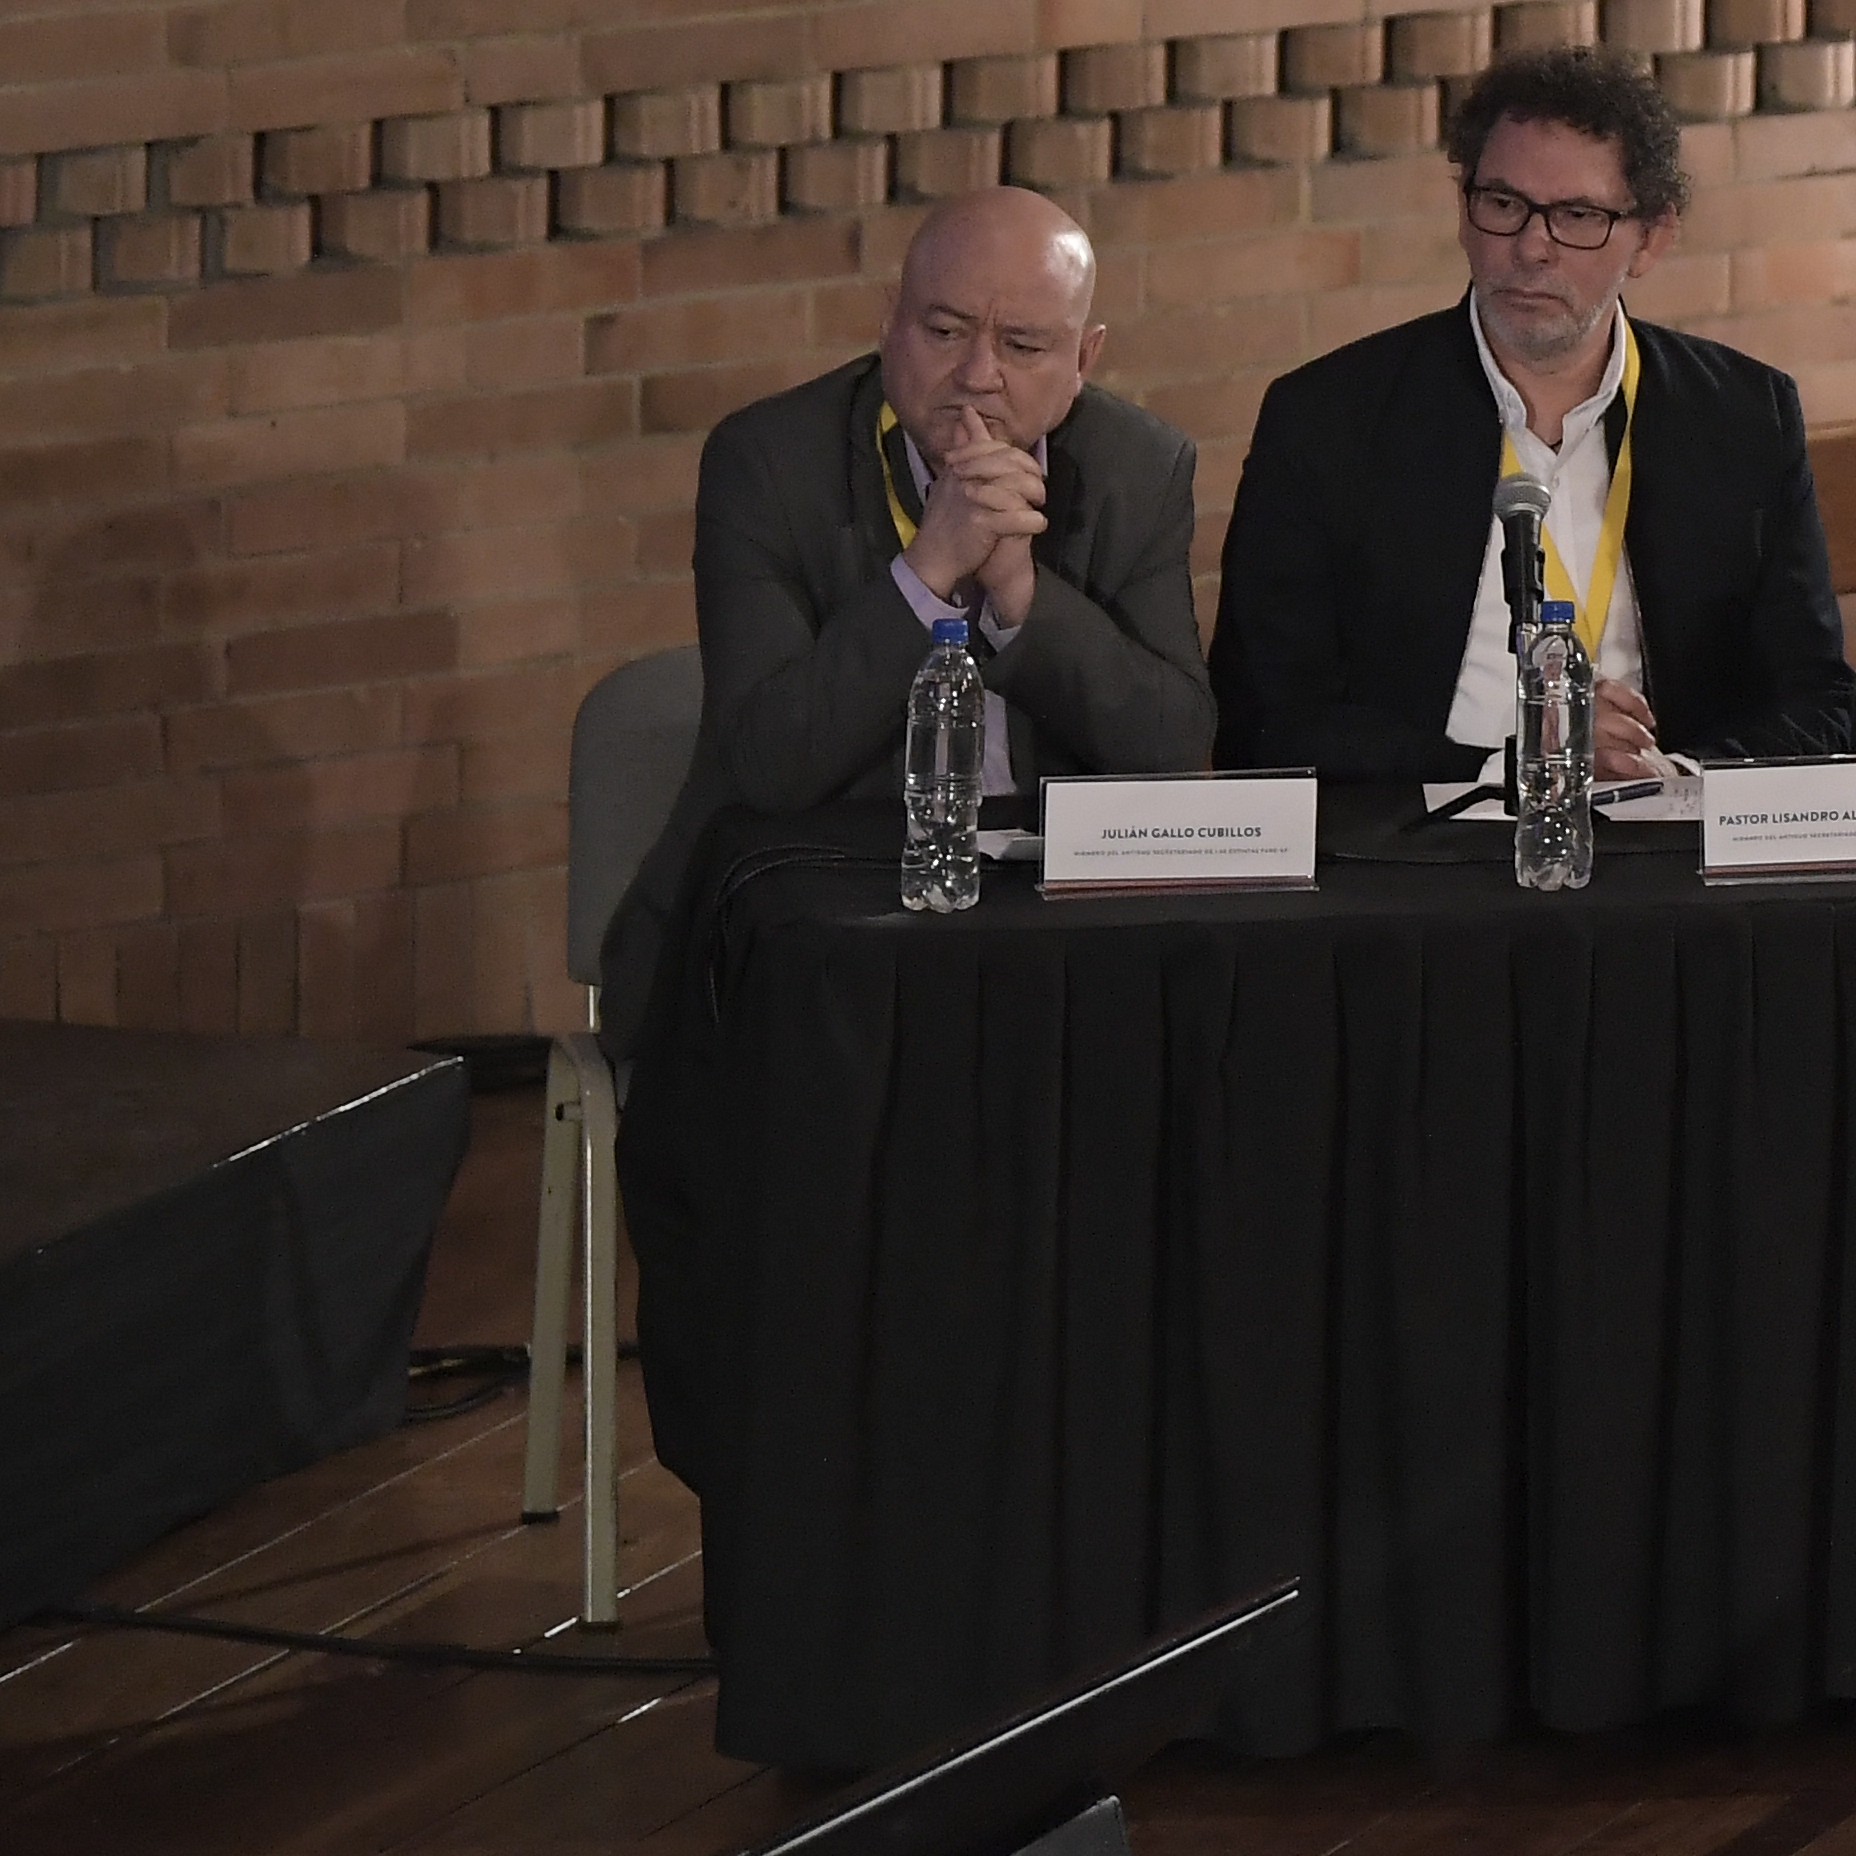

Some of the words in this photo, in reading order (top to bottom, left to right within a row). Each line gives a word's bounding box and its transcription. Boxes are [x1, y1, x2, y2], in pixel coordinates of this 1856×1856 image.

[1719, 813, 1769, 826] PASTOR
[1772, 811, 1839, 824] LISANDRO
[1101, 825, 1148, 839] JULIÁN
[1151, 827, 1195, 839] GALLO
[1198, 826, 1262, 838] CUBILLOS
